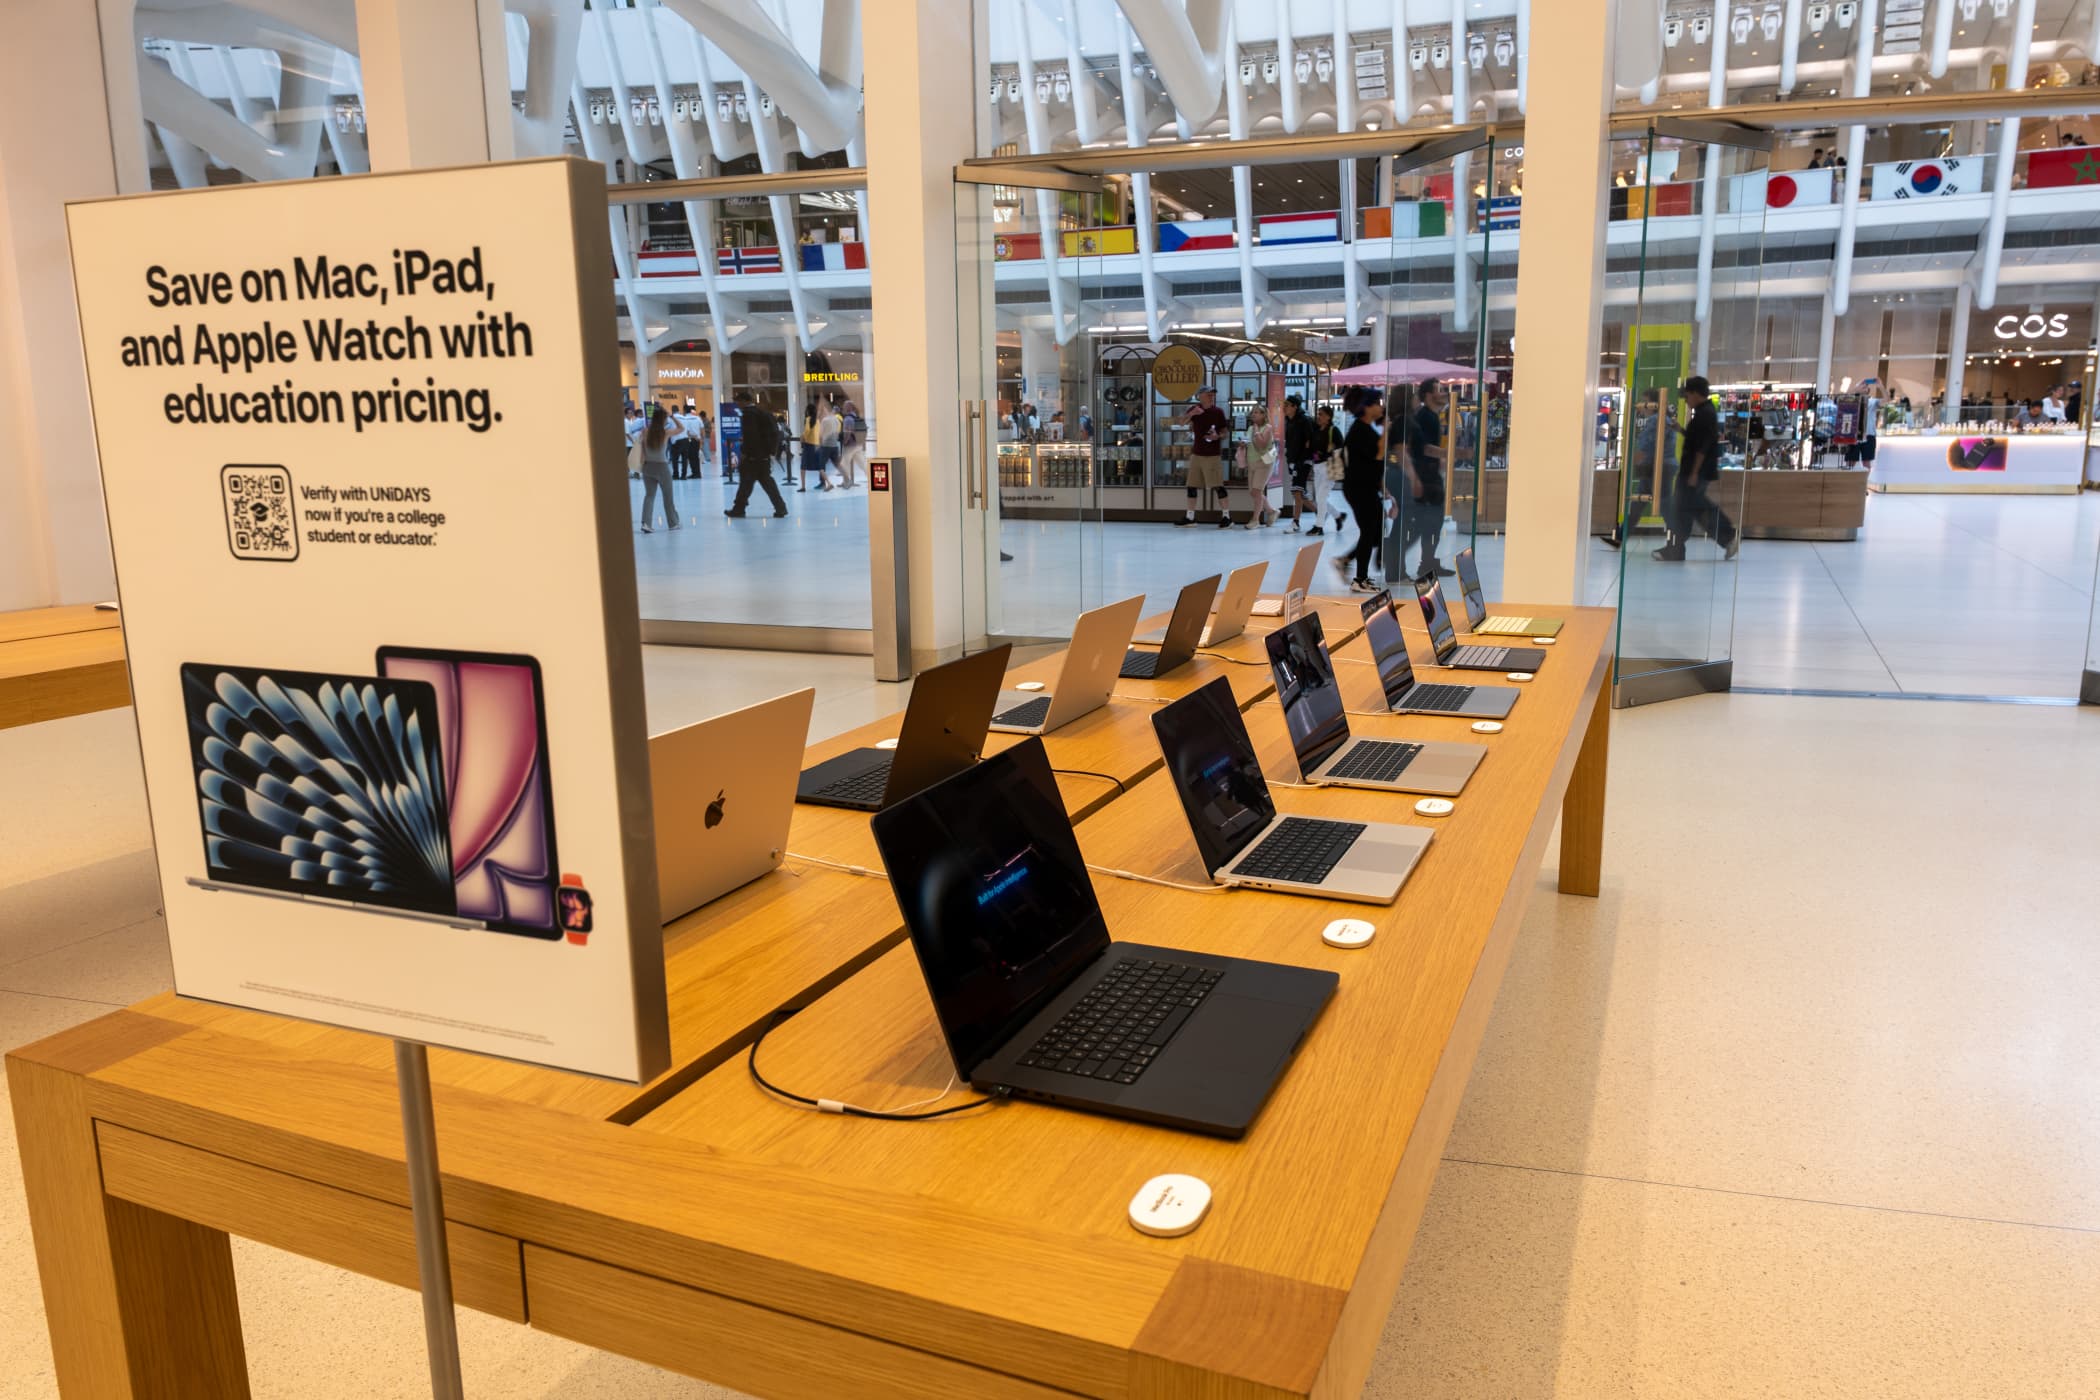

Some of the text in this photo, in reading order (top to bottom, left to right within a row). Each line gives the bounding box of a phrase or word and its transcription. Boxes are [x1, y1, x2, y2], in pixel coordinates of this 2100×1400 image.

[146, 246, 494, 307] Save on Mac, iPad,
[1994, 313, 2069, 339] COS
[121, 311, 533, 374] and Apple Watch with
[803, 372, 858, 382] BREITLING
[164, 377, 502, 433] education pricing.
[300, 486, 337, 503] Verify
[339, 486, 368, 501] with
[305, 507, 445, 528] now if you're a college
[307, 529, 356, 543] student
[358, 533, 371, 544] or
